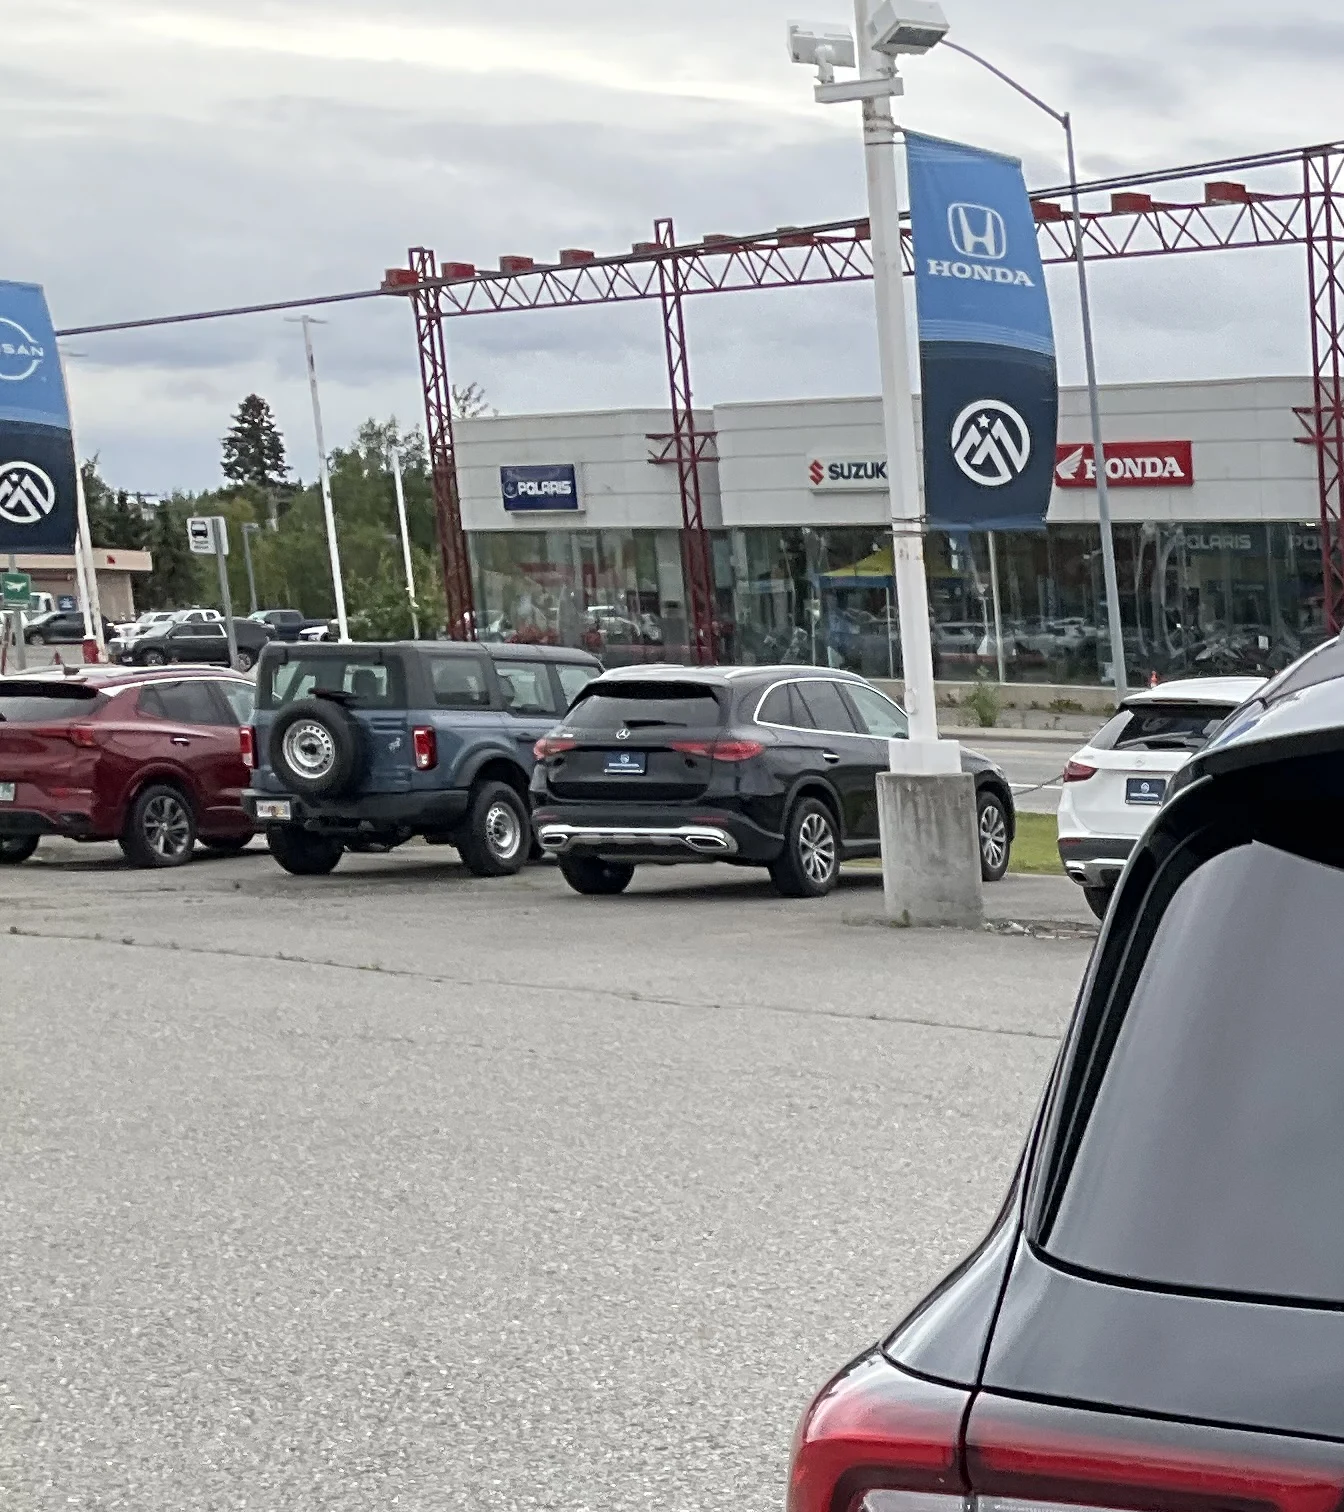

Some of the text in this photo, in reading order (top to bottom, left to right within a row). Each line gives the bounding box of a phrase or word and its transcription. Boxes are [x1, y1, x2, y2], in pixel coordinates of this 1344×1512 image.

[926, 259, 1036, 287] HONDA
[1, 343, 44, 357] SAN
[828, 461, 888, 480] SUZUK
[517, 480, 572, 496] POLARIS
